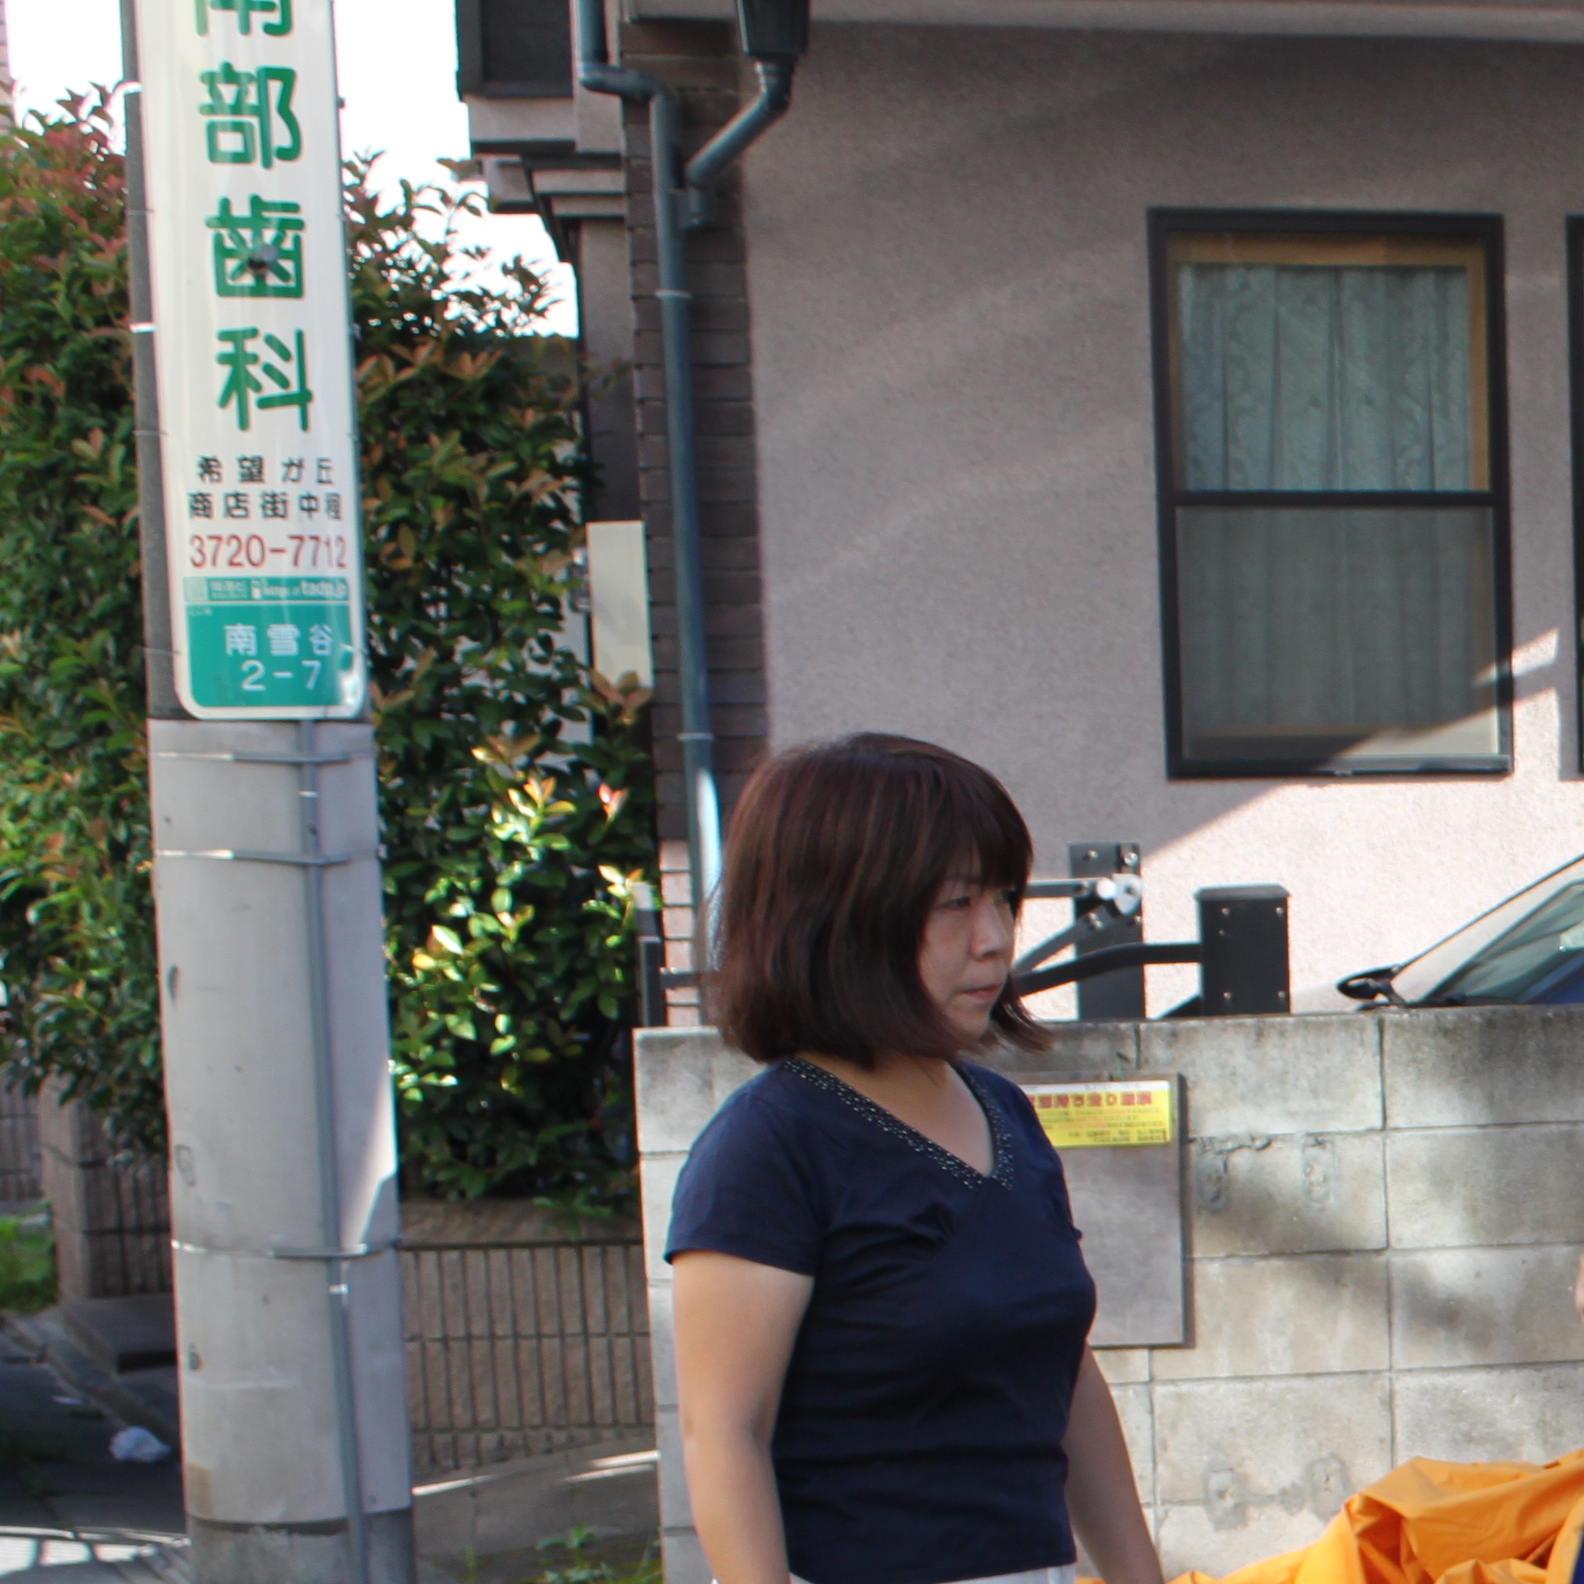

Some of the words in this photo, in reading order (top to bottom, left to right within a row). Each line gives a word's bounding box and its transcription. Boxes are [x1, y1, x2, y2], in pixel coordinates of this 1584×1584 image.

[190, 534, 347, 568] 3720-7712
[223, 623, 333, 657] 南雪谷
[241, 660, 322, 691] 2-7
